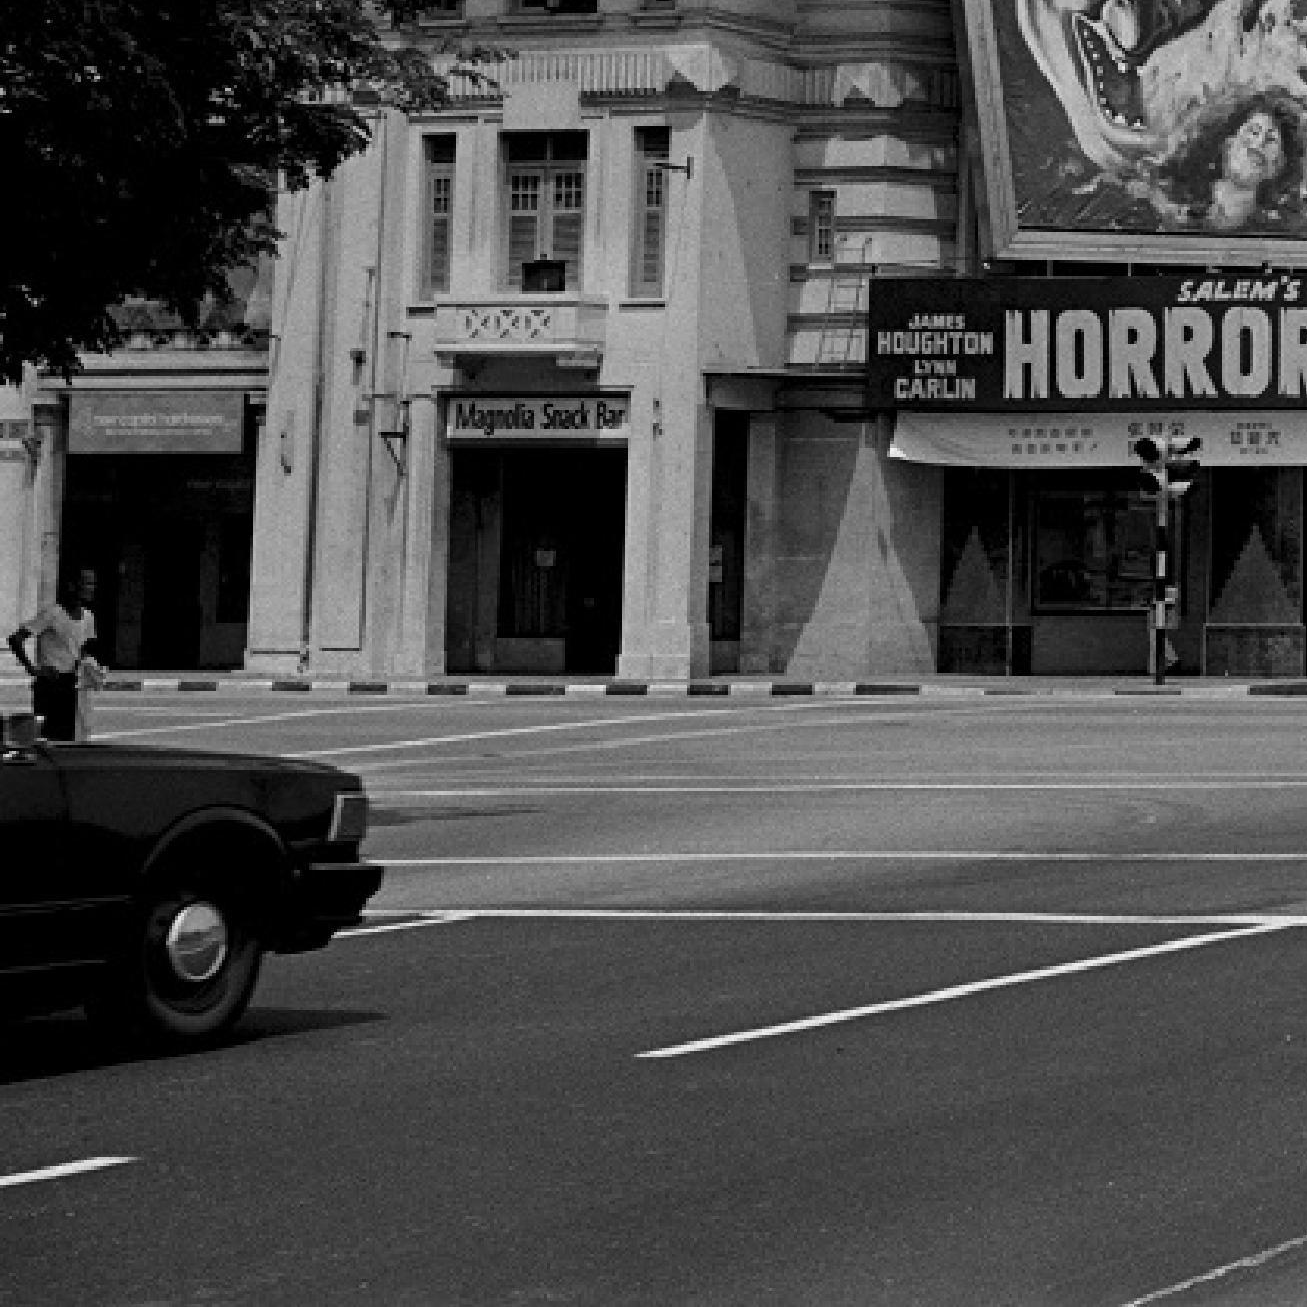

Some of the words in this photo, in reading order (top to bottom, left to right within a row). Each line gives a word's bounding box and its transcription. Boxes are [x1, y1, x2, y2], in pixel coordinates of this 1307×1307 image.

[1177, 276, 1301, 302] SALEM'S
[908, 313, 966, 331] JAMES
[878, 331, 994, 355] HOUGHTON
[914, 359, 957, 378] LYNN
[895, 377, 976, 400] CARLIN
[456, 400, 535, 435] Magnolia
[540, 400, 591, 431] Snack
[597, 400, 626, 431] Bar
